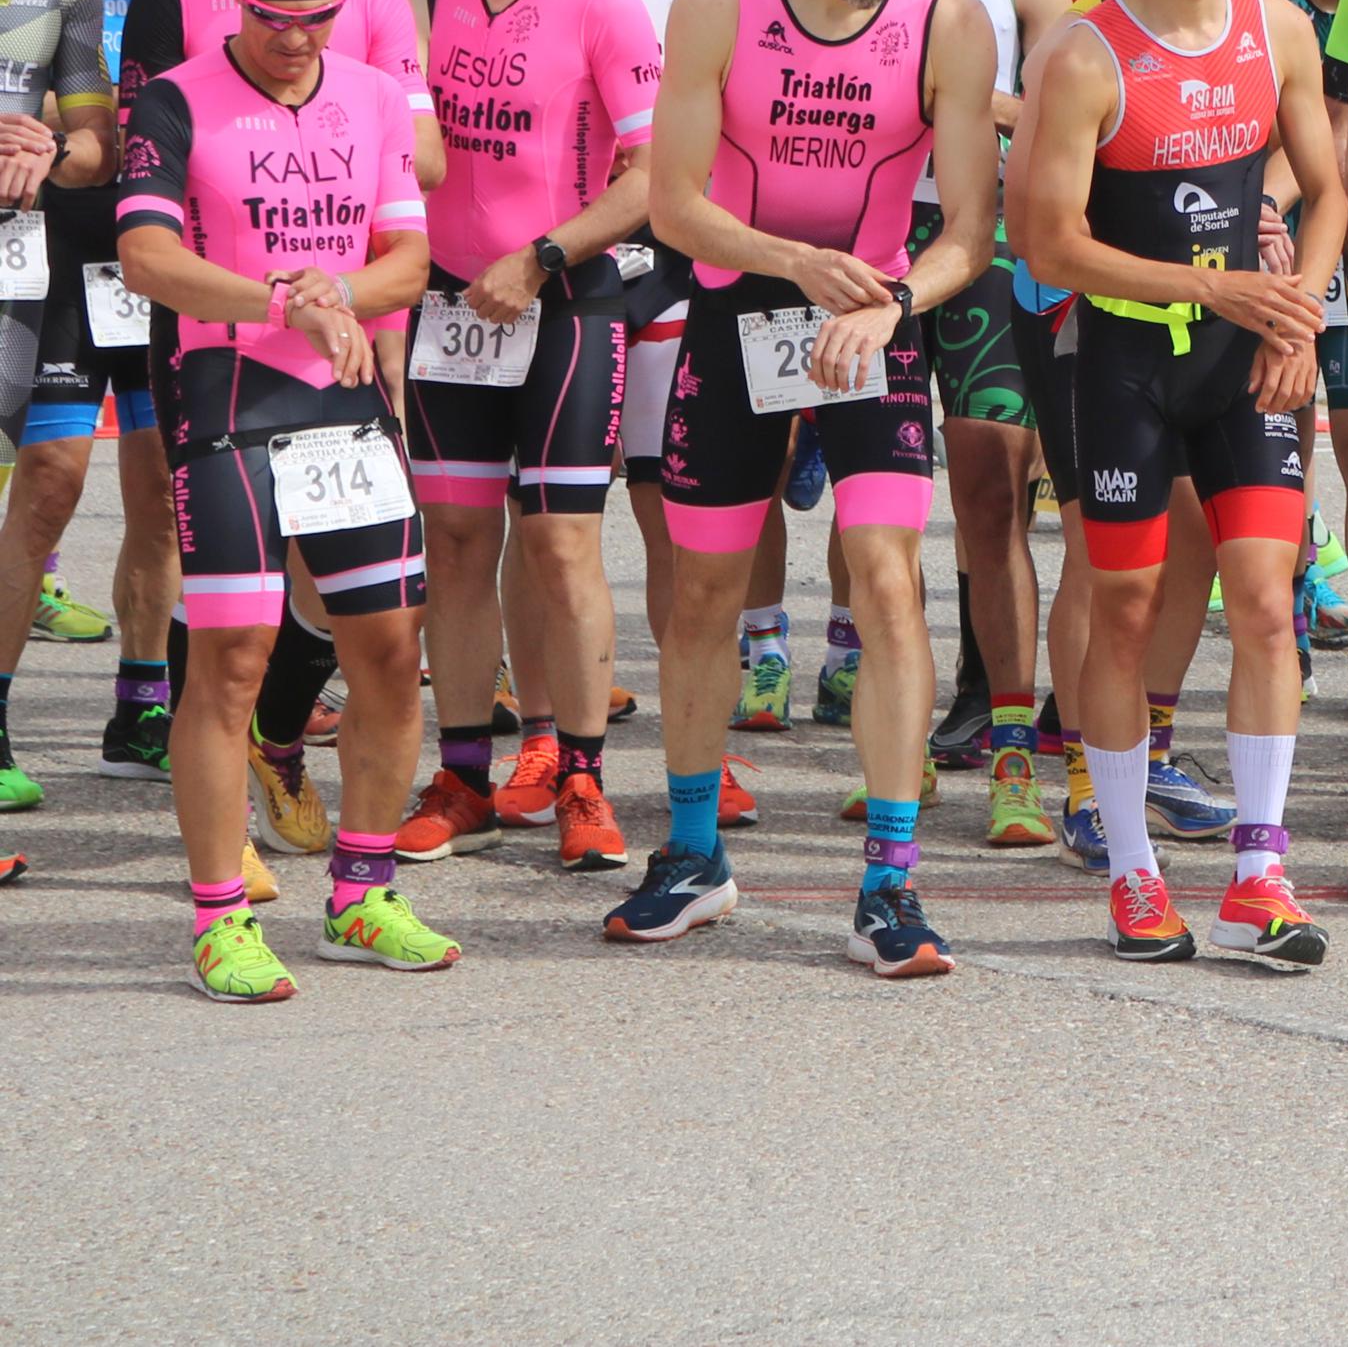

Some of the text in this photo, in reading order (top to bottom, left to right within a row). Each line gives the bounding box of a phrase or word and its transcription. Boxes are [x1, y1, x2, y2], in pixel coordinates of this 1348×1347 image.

[440, 45, 527, 88] JESÚS
[781, 68, 872, 102] Triatlón
[432, 85, 532, 132] Triatlón
[769, 100, 876, 135] Pisuerga
[769, 135, 866, 168] MERINO
[1153, 119, 1260, 166] HERNANDO
[249, 145, 354, 184] KALY
[242, 193, 366, 230] Triatlón
[1190, 206, 1239, 224] Diputación
[1190, 218, 1230, 232] de Soria
[264, 231, 355, 256] Pisuerga
[443, 322, 503, 359] 301
[769, 323, 820, 333] CASTILL
[610, 322, 625, 404] Valladolid
[291, 447, 346, 460] CASTILLA
[304, 459, 374, 503] 314
[1093, 467, 1138, 492] MAD
[175, 465, 196, 553] Valladolid
